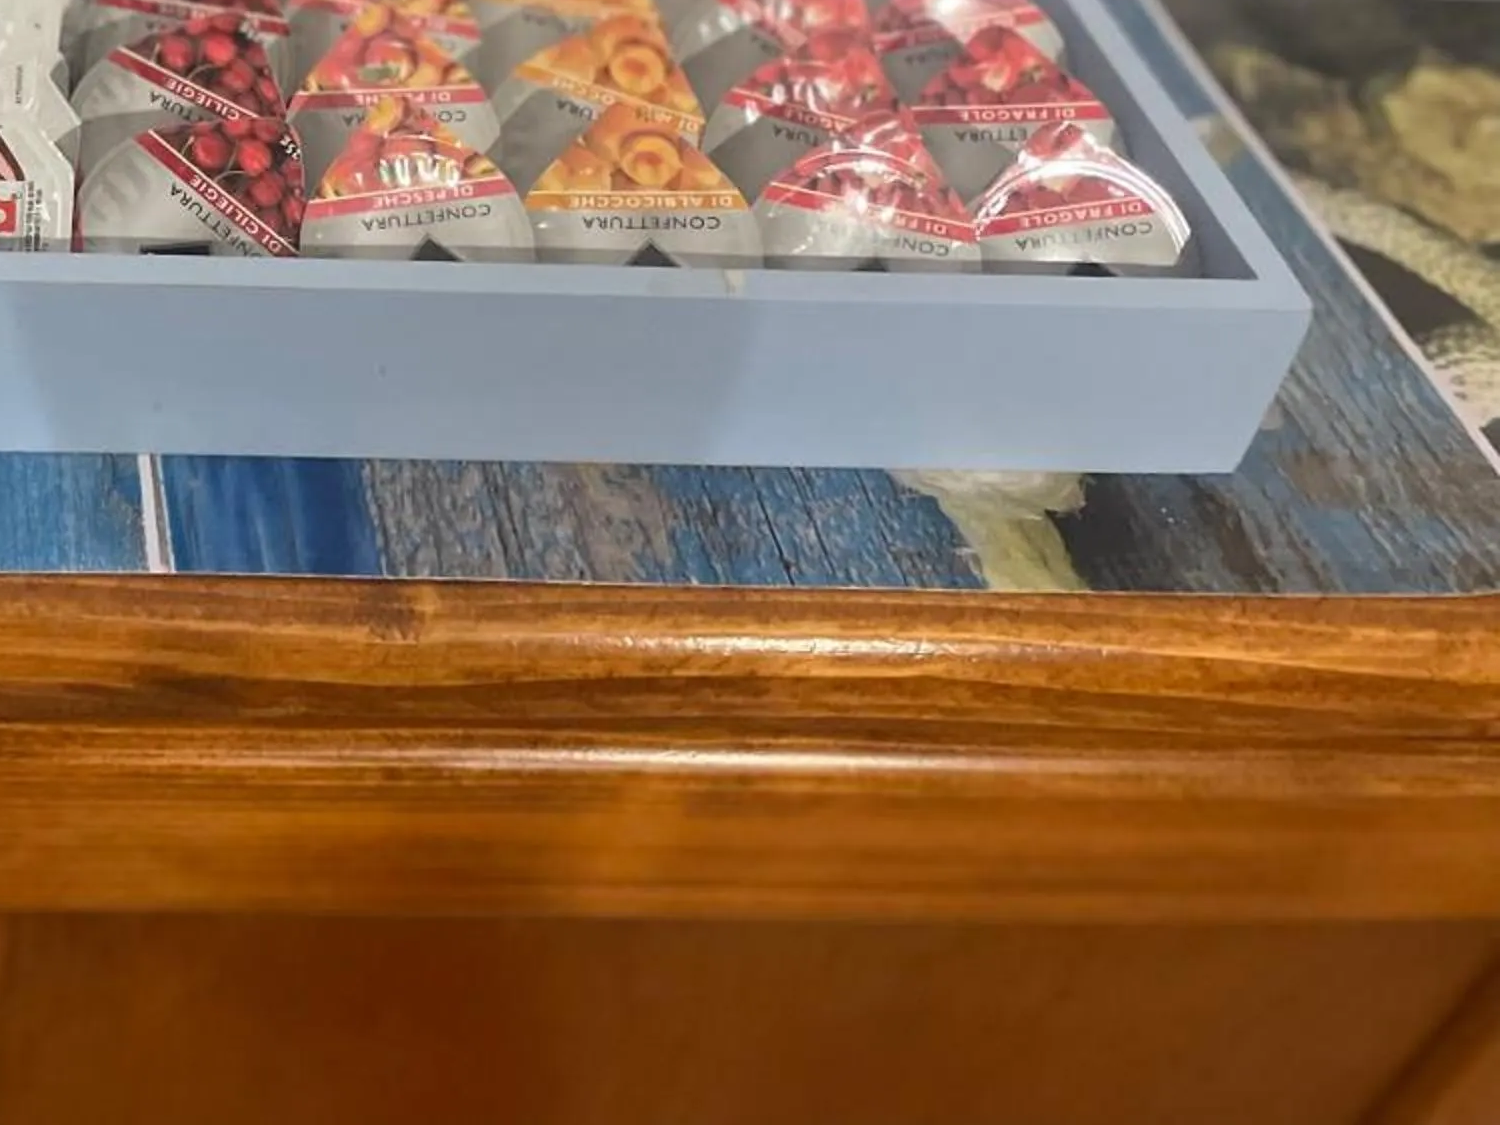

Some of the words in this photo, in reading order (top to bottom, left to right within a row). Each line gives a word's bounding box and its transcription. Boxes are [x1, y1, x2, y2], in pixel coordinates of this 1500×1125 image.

[163, 77, 241, 121] CILIEGIE
[960, 108, 1048, 121] FRAGOLE
[1054, 107, 1076, 119] DI
[954, 127, 1028, 144] ETTURA
[372, 189, 447, 209] PESCHE
[451, 184, 475, 198] DI
[188, 174, 260, 235] CILIEGIE
[569, 195, 701, 209] ALBICOCCHE
[711, 195, 734, 208] DI
[1120, 200, 1143, 215] DI
[361, 203, 492, 232] CONFETTURA
[582, 215, 722, 231] CONFETTURA
[1019, 202, 1114, 228] FRAGOLE
[925, 218, 948, 236] DI
[261, 233, 283, 254] DI
